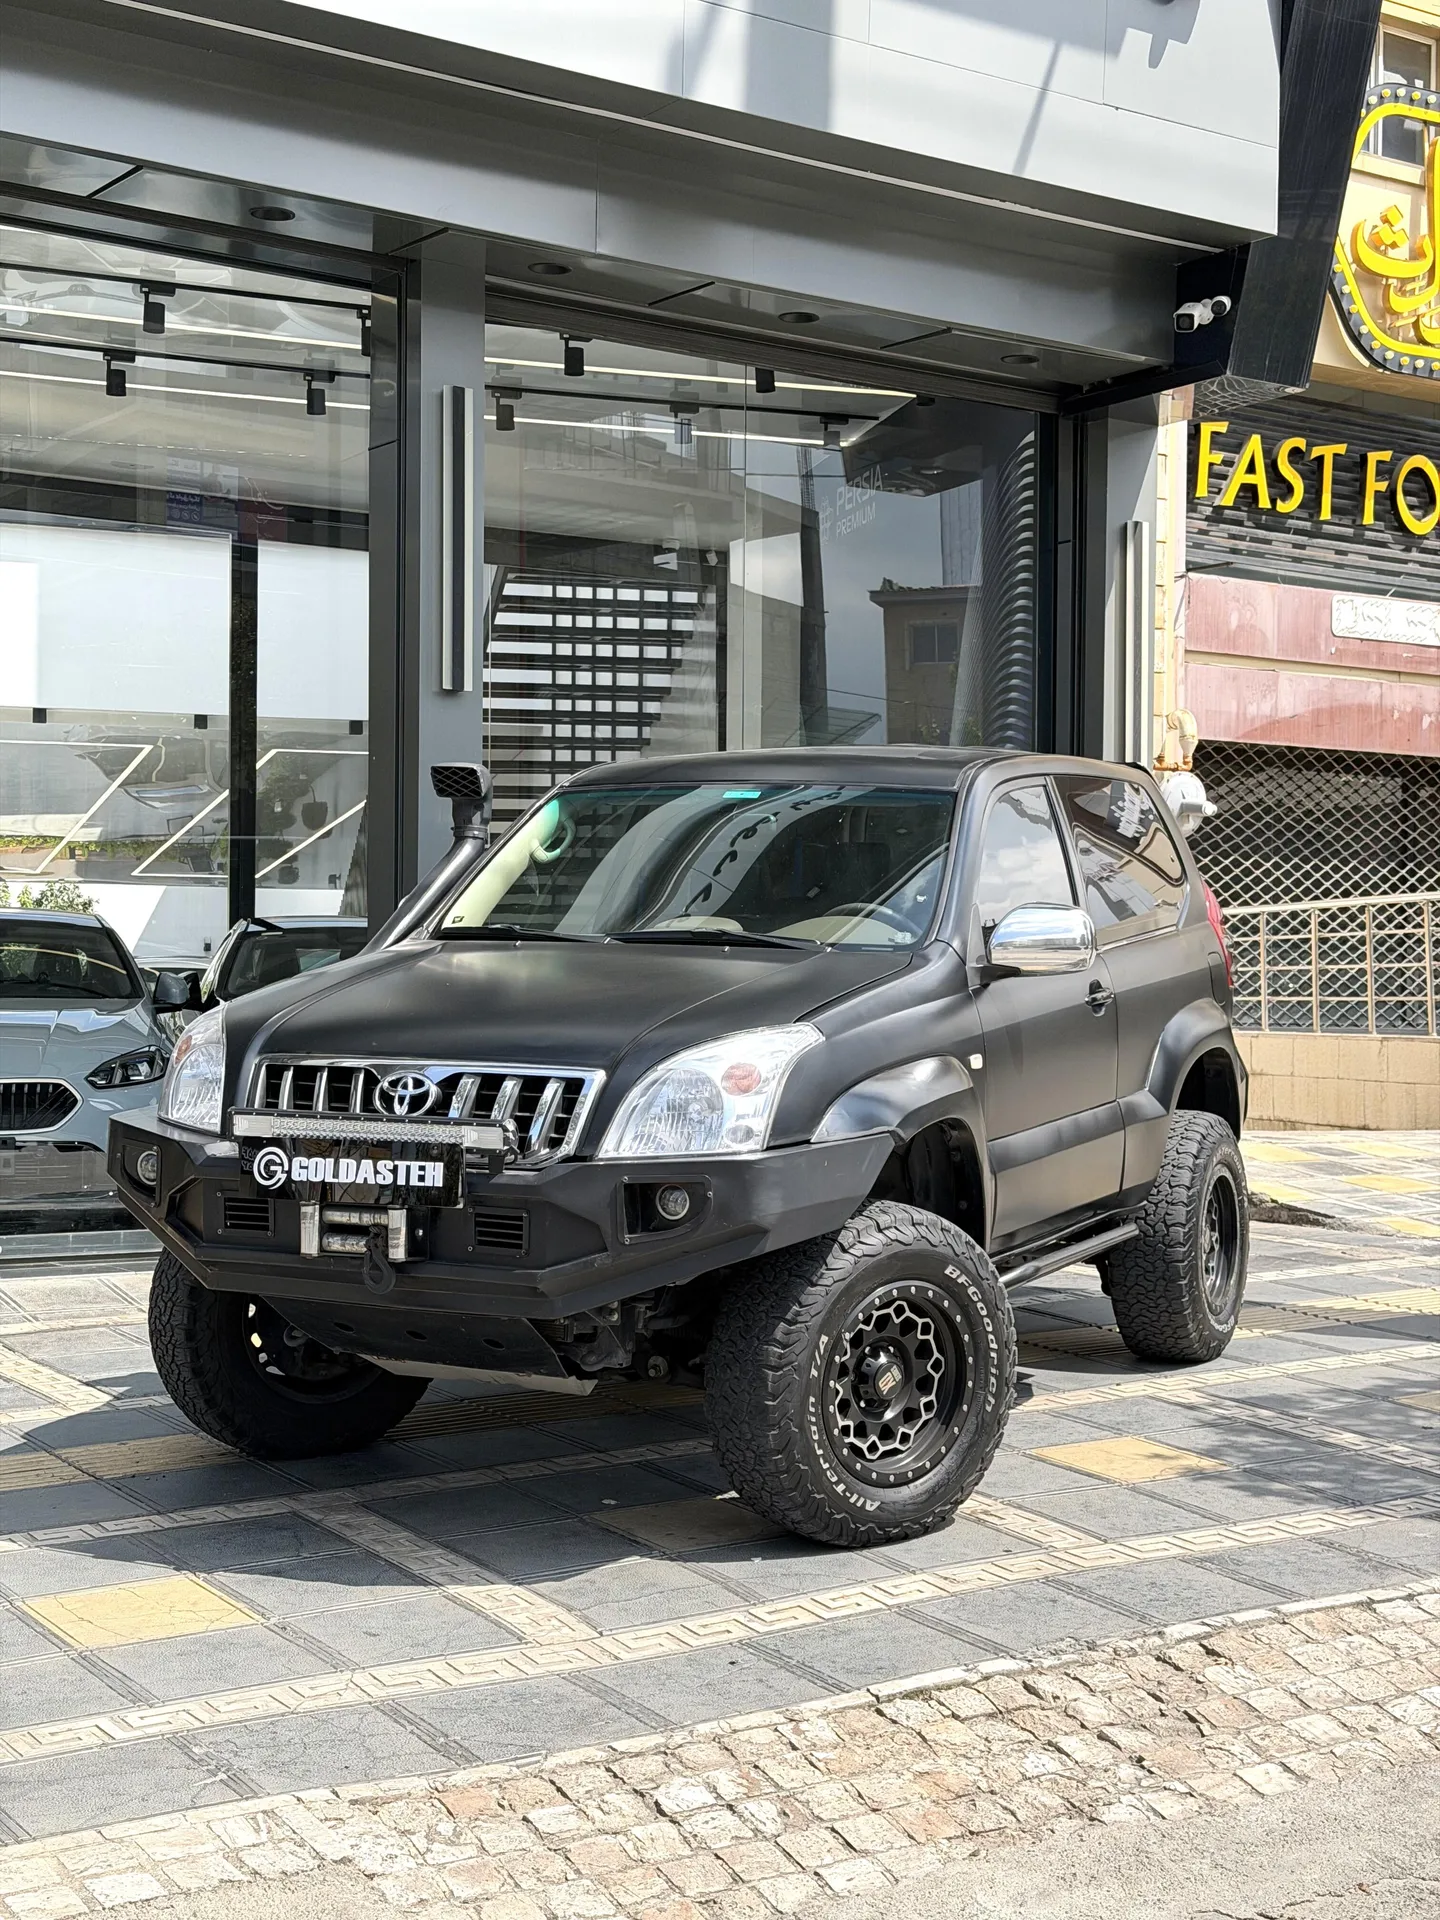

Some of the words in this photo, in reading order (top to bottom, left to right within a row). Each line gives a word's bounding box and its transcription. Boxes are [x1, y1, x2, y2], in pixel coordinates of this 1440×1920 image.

[836, 464, 883, 516] PERSIA
[1195, 421, 1348, 521] FAST
[1362, 450, 1440, 536] FO
[836, 501, 876, 540] PREMIUM
[291, 1156, 445, 1188] GOLDASTEH
[809, 1334, 829, 1379] T/A
[944, 1264, 999, 1413] BFGoodrich
[807, 1395, 881, 1512] All-Terrain
